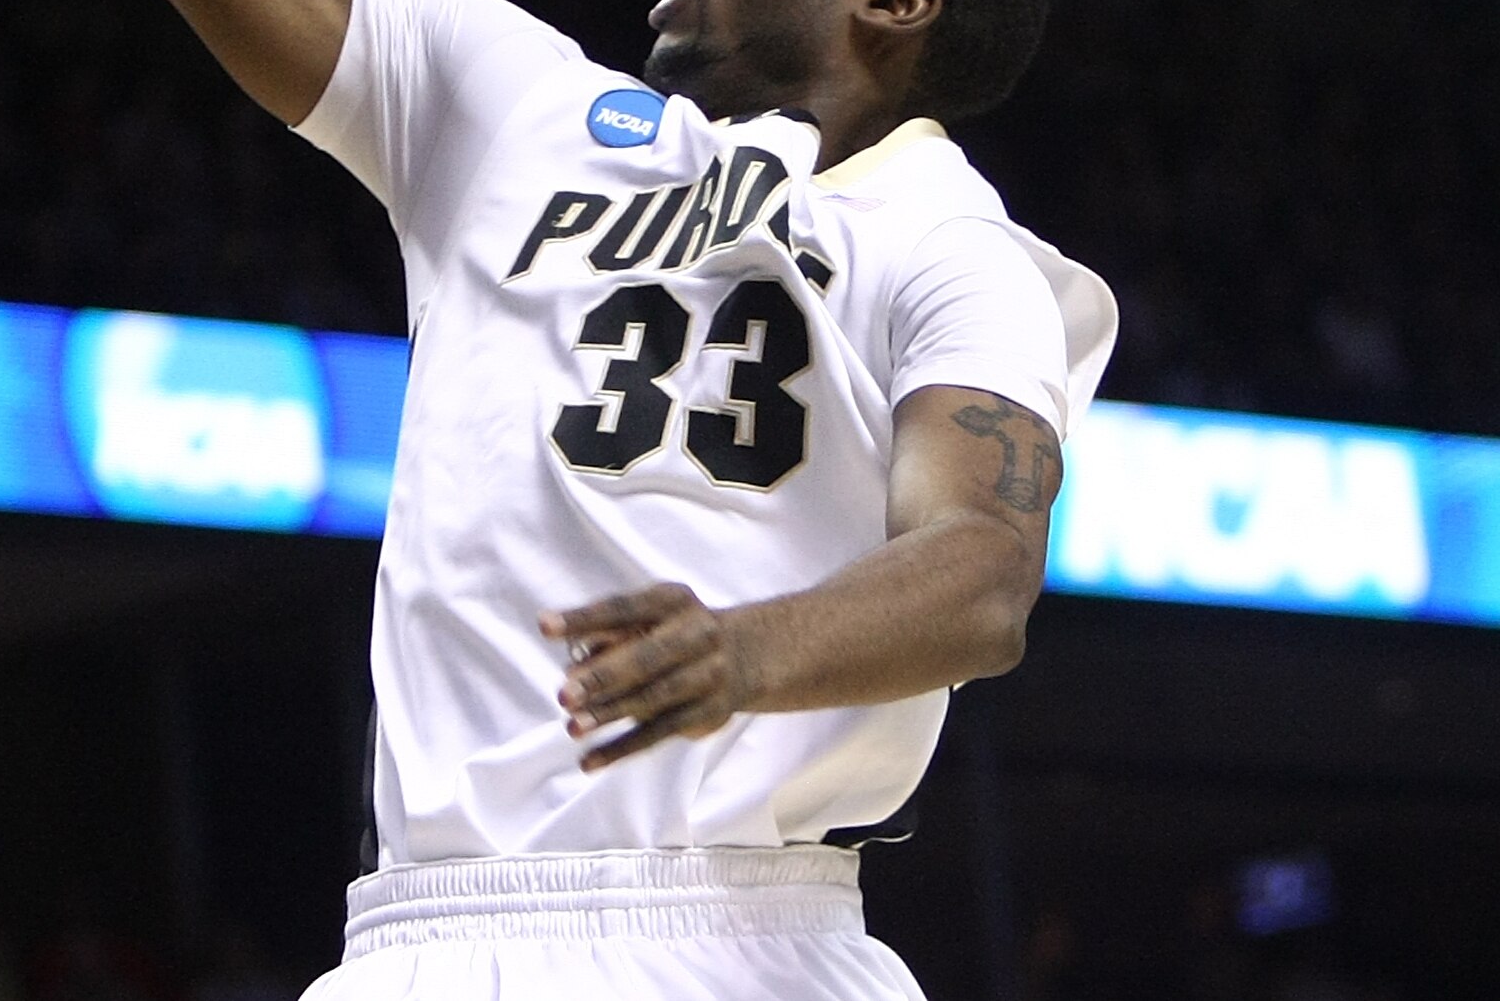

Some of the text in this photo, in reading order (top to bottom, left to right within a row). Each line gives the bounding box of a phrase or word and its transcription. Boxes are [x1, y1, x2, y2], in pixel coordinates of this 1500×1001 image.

[595, 107, 654, 136] NCAA
[500, 145, 836, 298] PURD
[546, 281, 815, 494] 33
[1062, 403, 1430, 606] NCAA
